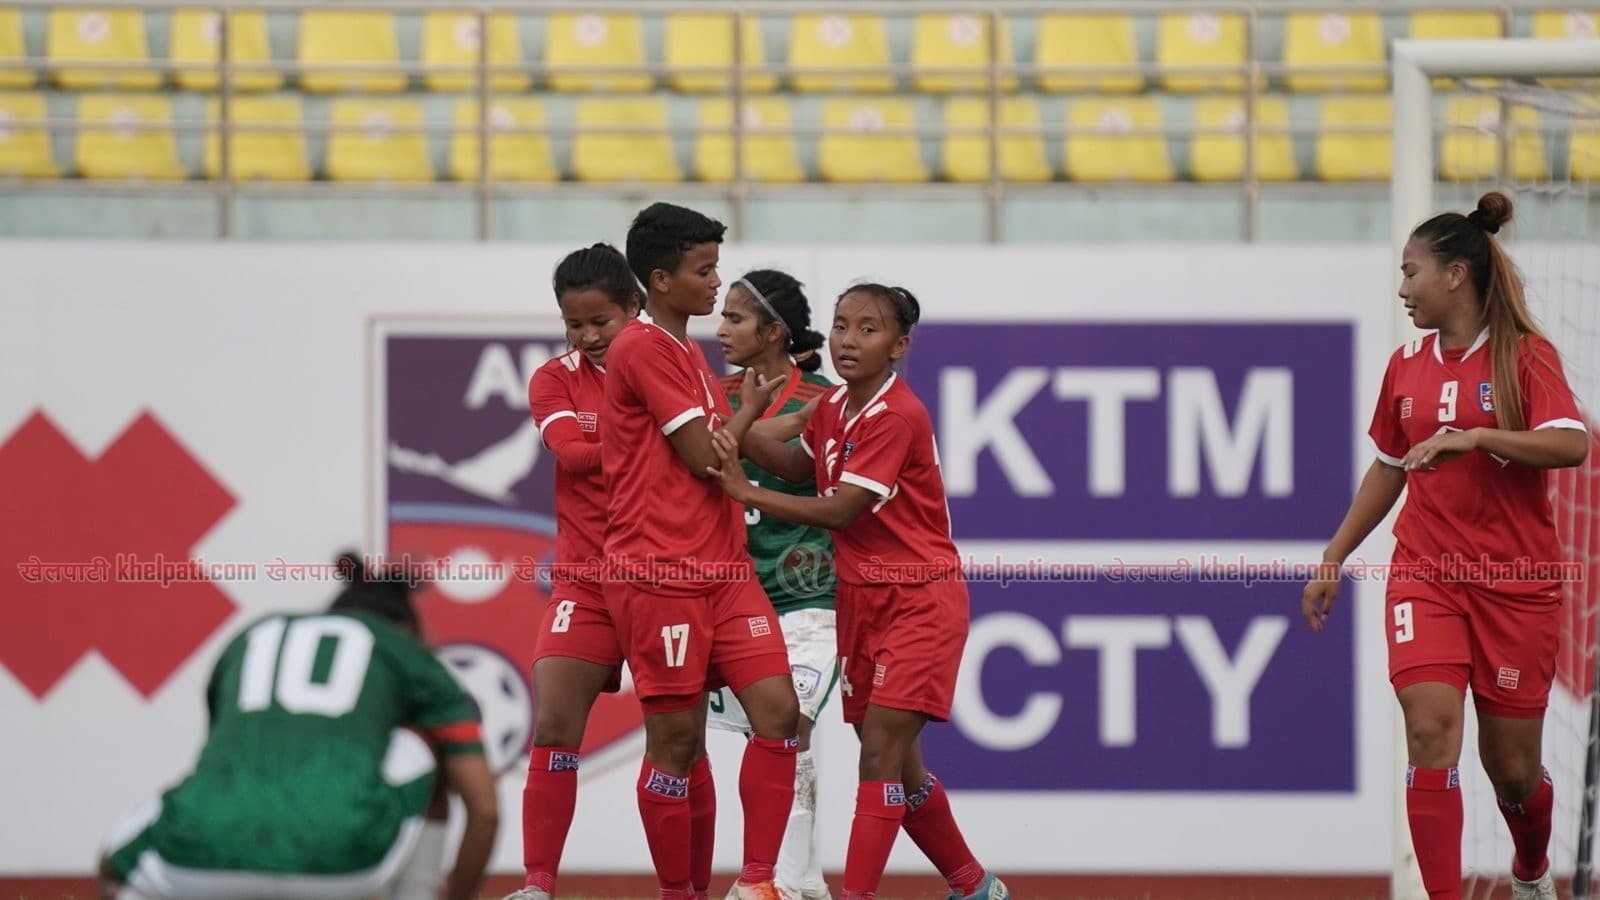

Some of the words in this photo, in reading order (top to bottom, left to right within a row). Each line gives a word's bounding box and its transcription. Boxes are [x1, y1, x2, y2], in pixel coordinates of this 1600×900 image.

[1438, 380, 1458, 422] 9
[940, 366, 1294, 498] KTM
[551, 600, 577, 633] 8
[1394, 602, 1415, 643] 9
[660, 622, 690, 668] 17
[237, 615, 376, 718] 10
[950, 611, 1291, 751] CTY
[650, 783, 685, 797] CTY
[654, 772, 687, 787] KTM
